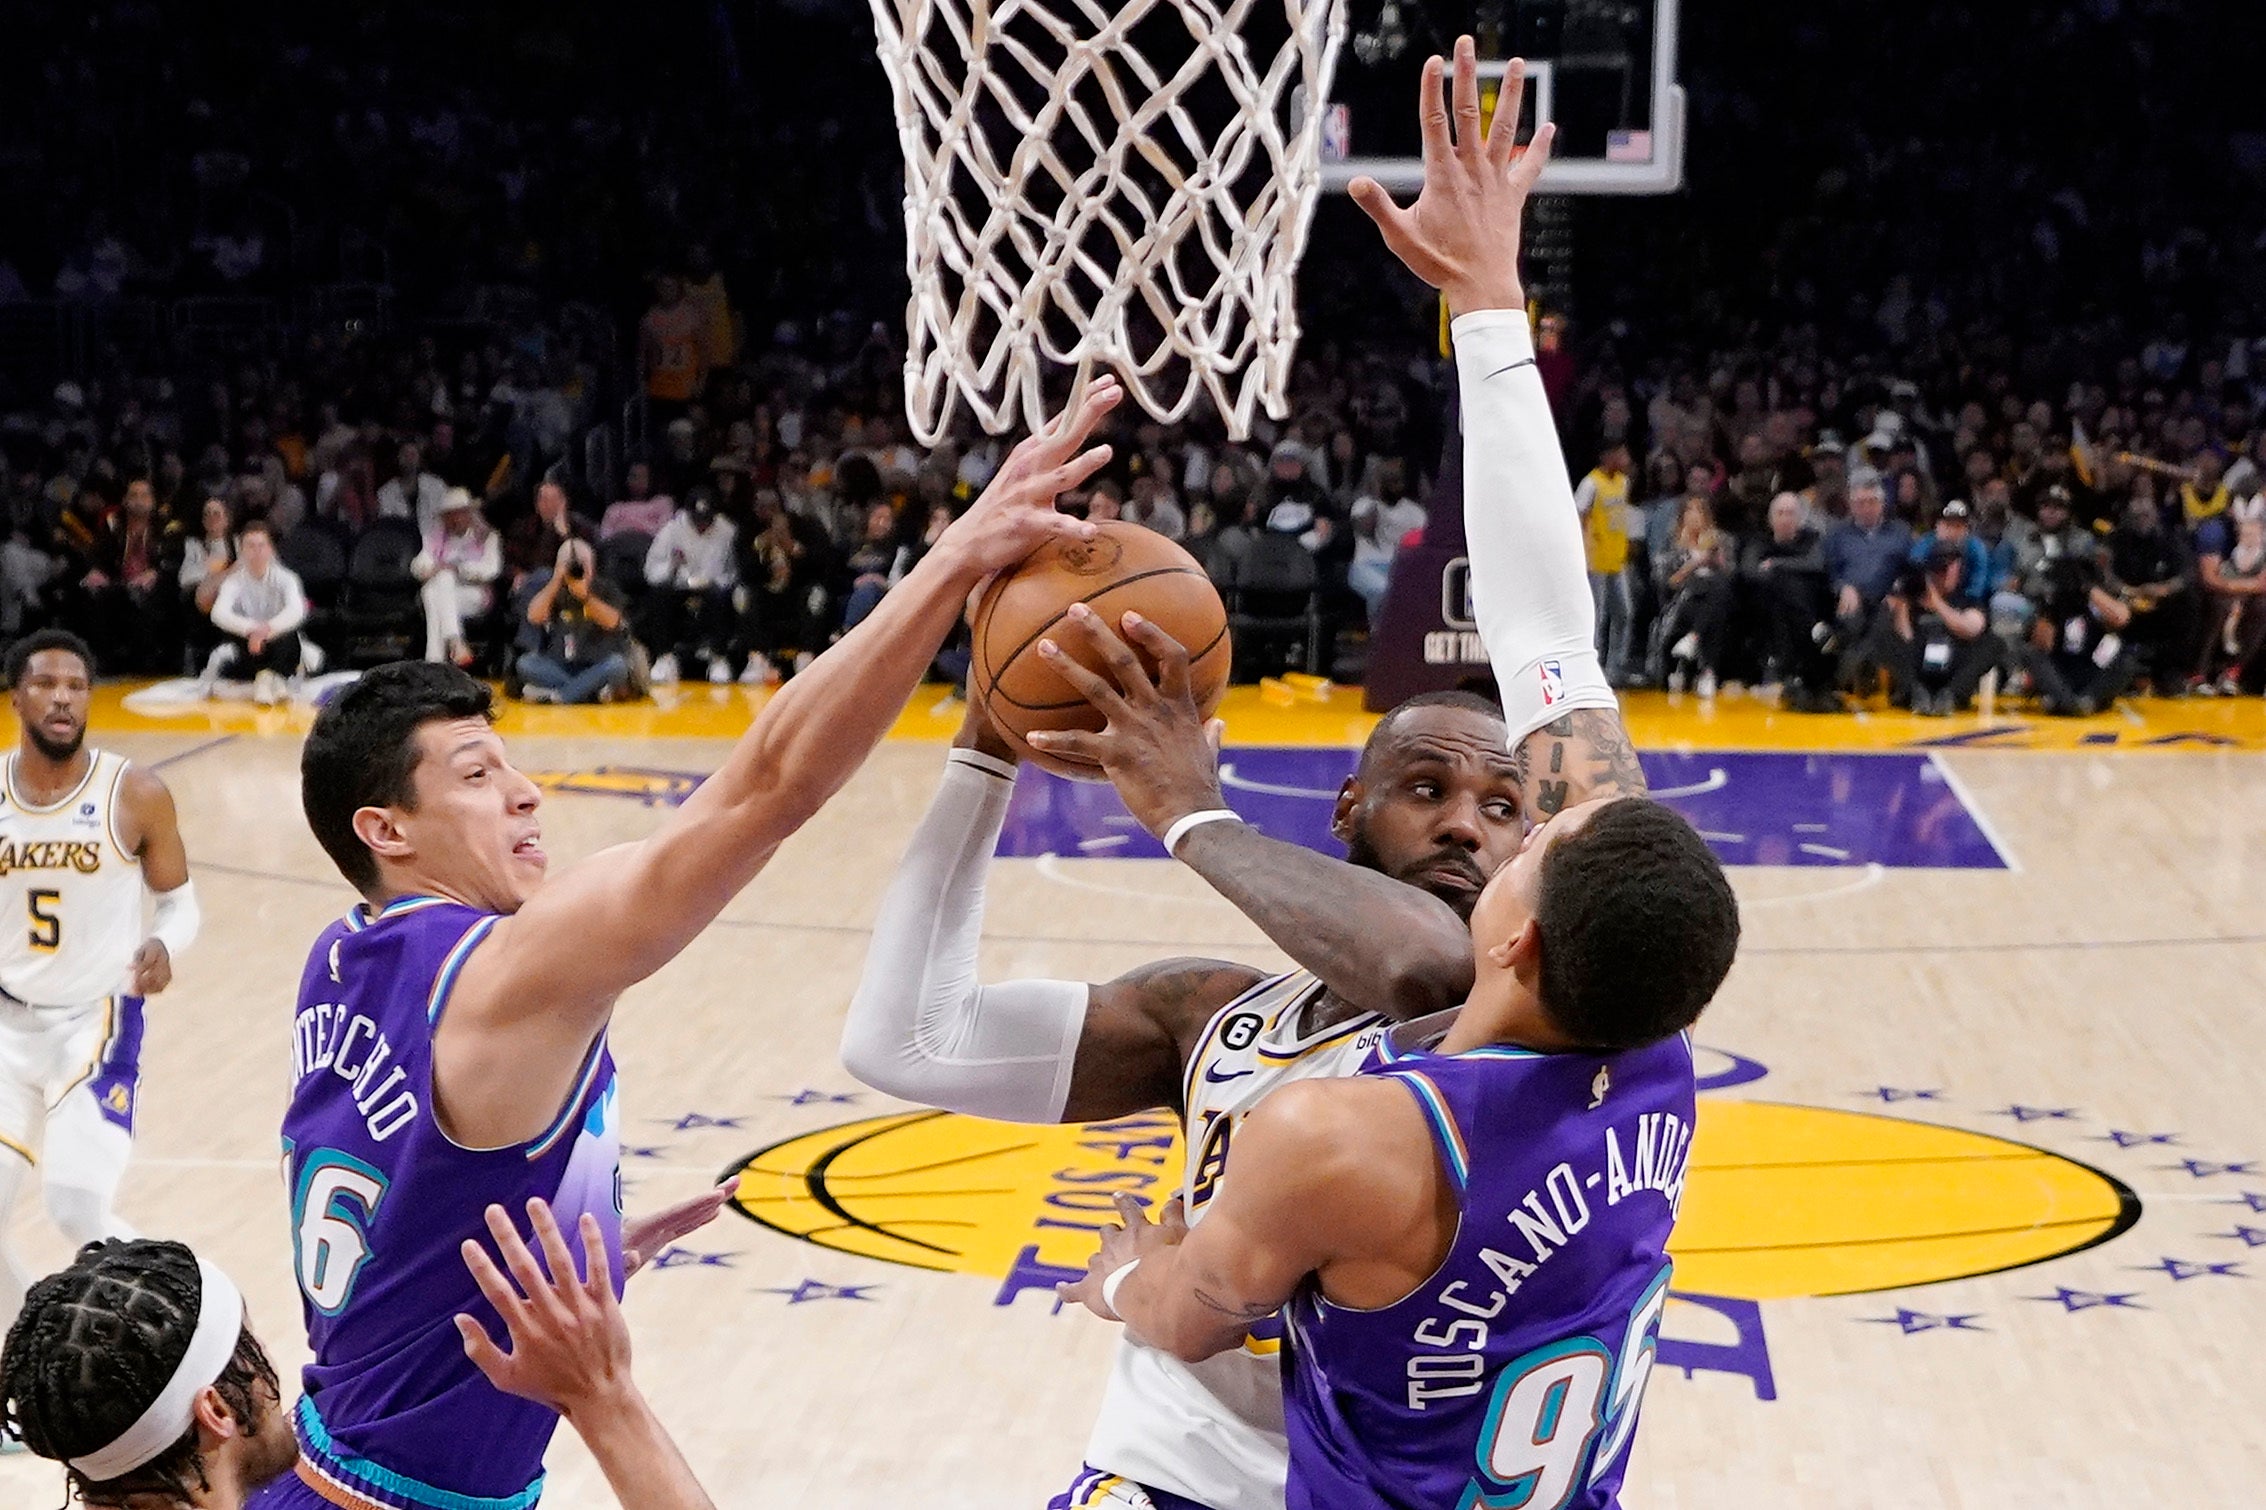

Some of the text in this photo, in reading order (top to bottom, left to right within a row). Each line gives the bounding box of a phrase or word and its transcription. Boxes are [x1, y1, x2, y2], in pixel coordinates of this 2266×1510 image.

[27, 887, 60, 954] 5
[1226, 1016, 1257, 1047] 6
[281, 1135, 390, 1317] 6
[1454, 1263, 1673, 1510] 95
